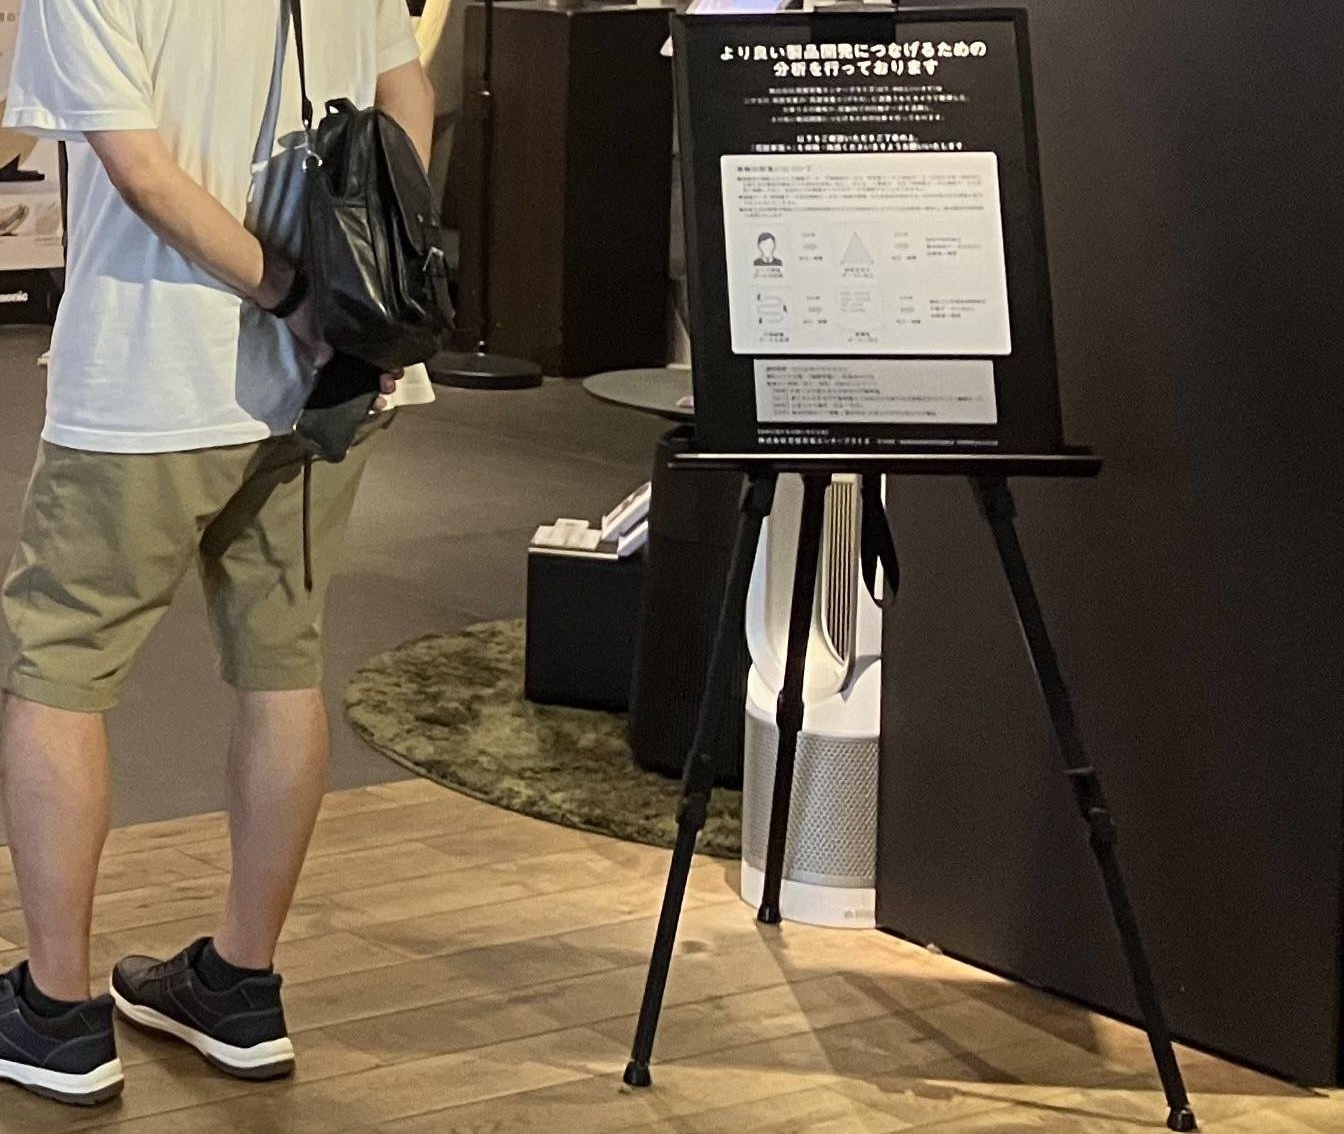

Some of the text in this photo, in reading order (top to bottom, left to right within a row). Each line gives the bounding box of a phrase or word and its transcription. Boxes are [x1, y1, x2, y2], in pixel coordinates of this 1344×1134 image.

[773, 58, 940, 78] 分析を行っております
